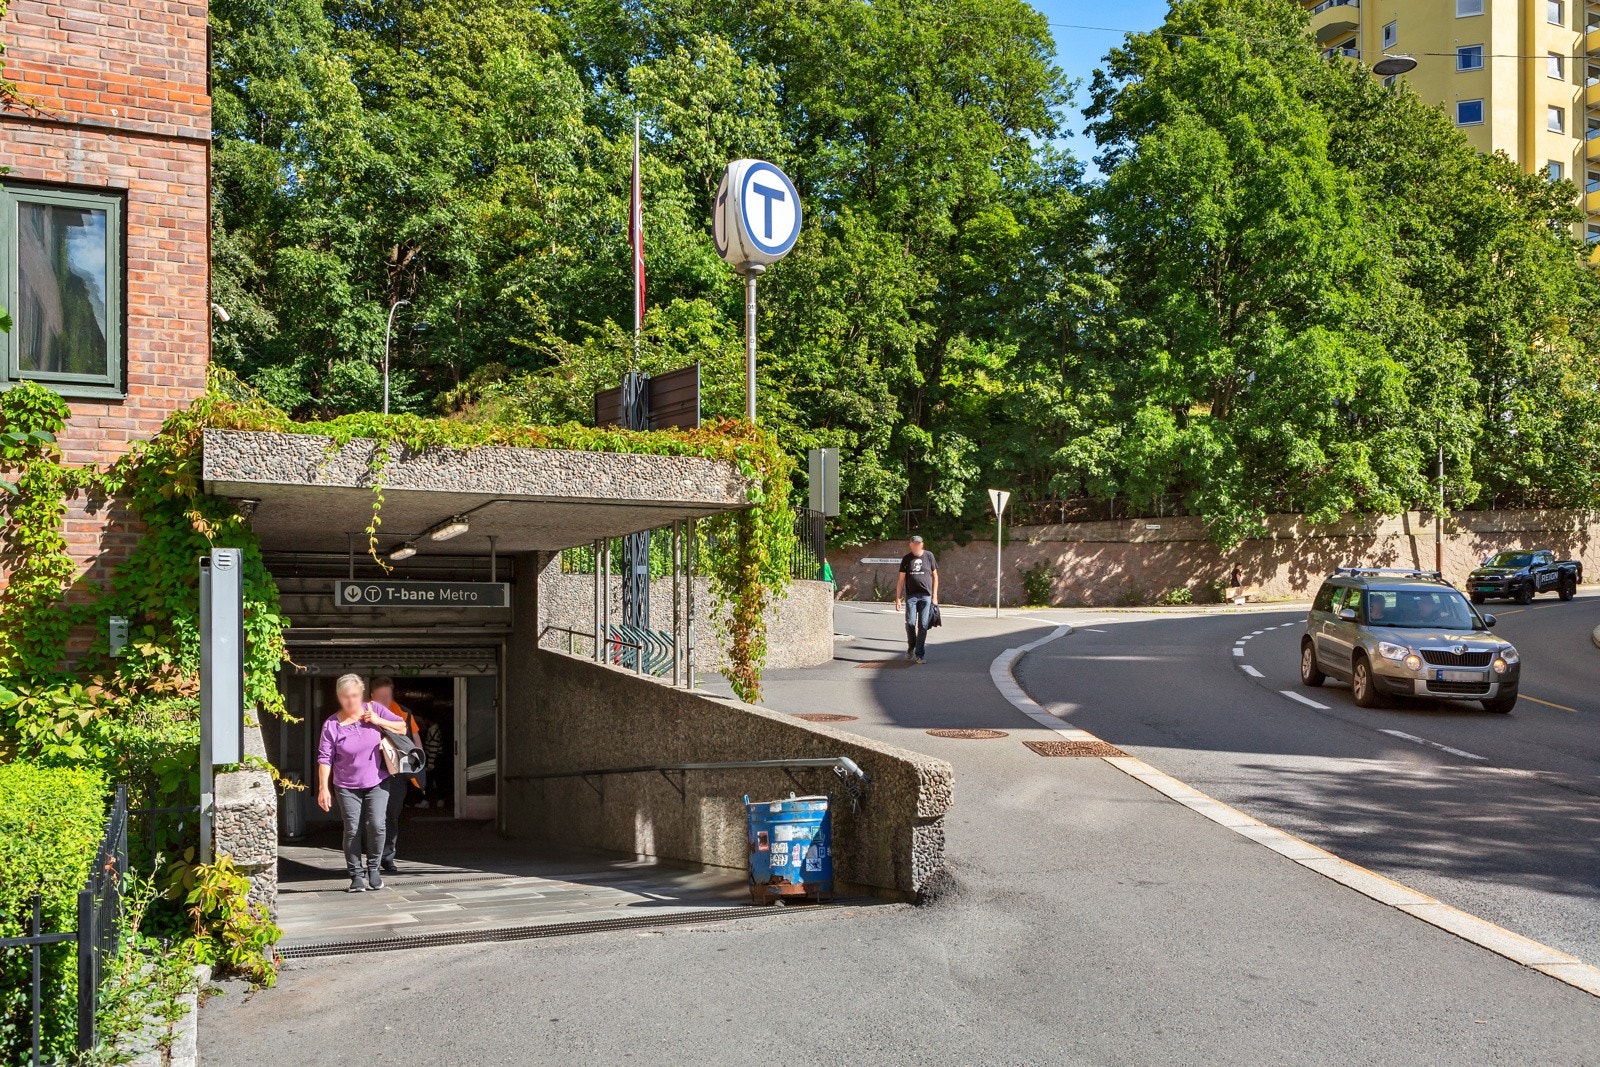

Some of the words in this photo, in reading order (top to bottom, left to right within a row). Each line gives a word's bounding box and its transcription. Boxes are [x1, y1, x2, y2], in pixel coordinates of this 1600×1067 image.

[753, 182, 785, 239] T
[1541, 571, 1558, 582] REIGN
[386, 587, 435, 600] T-bane
[439, 588, 478, 601] Metro
